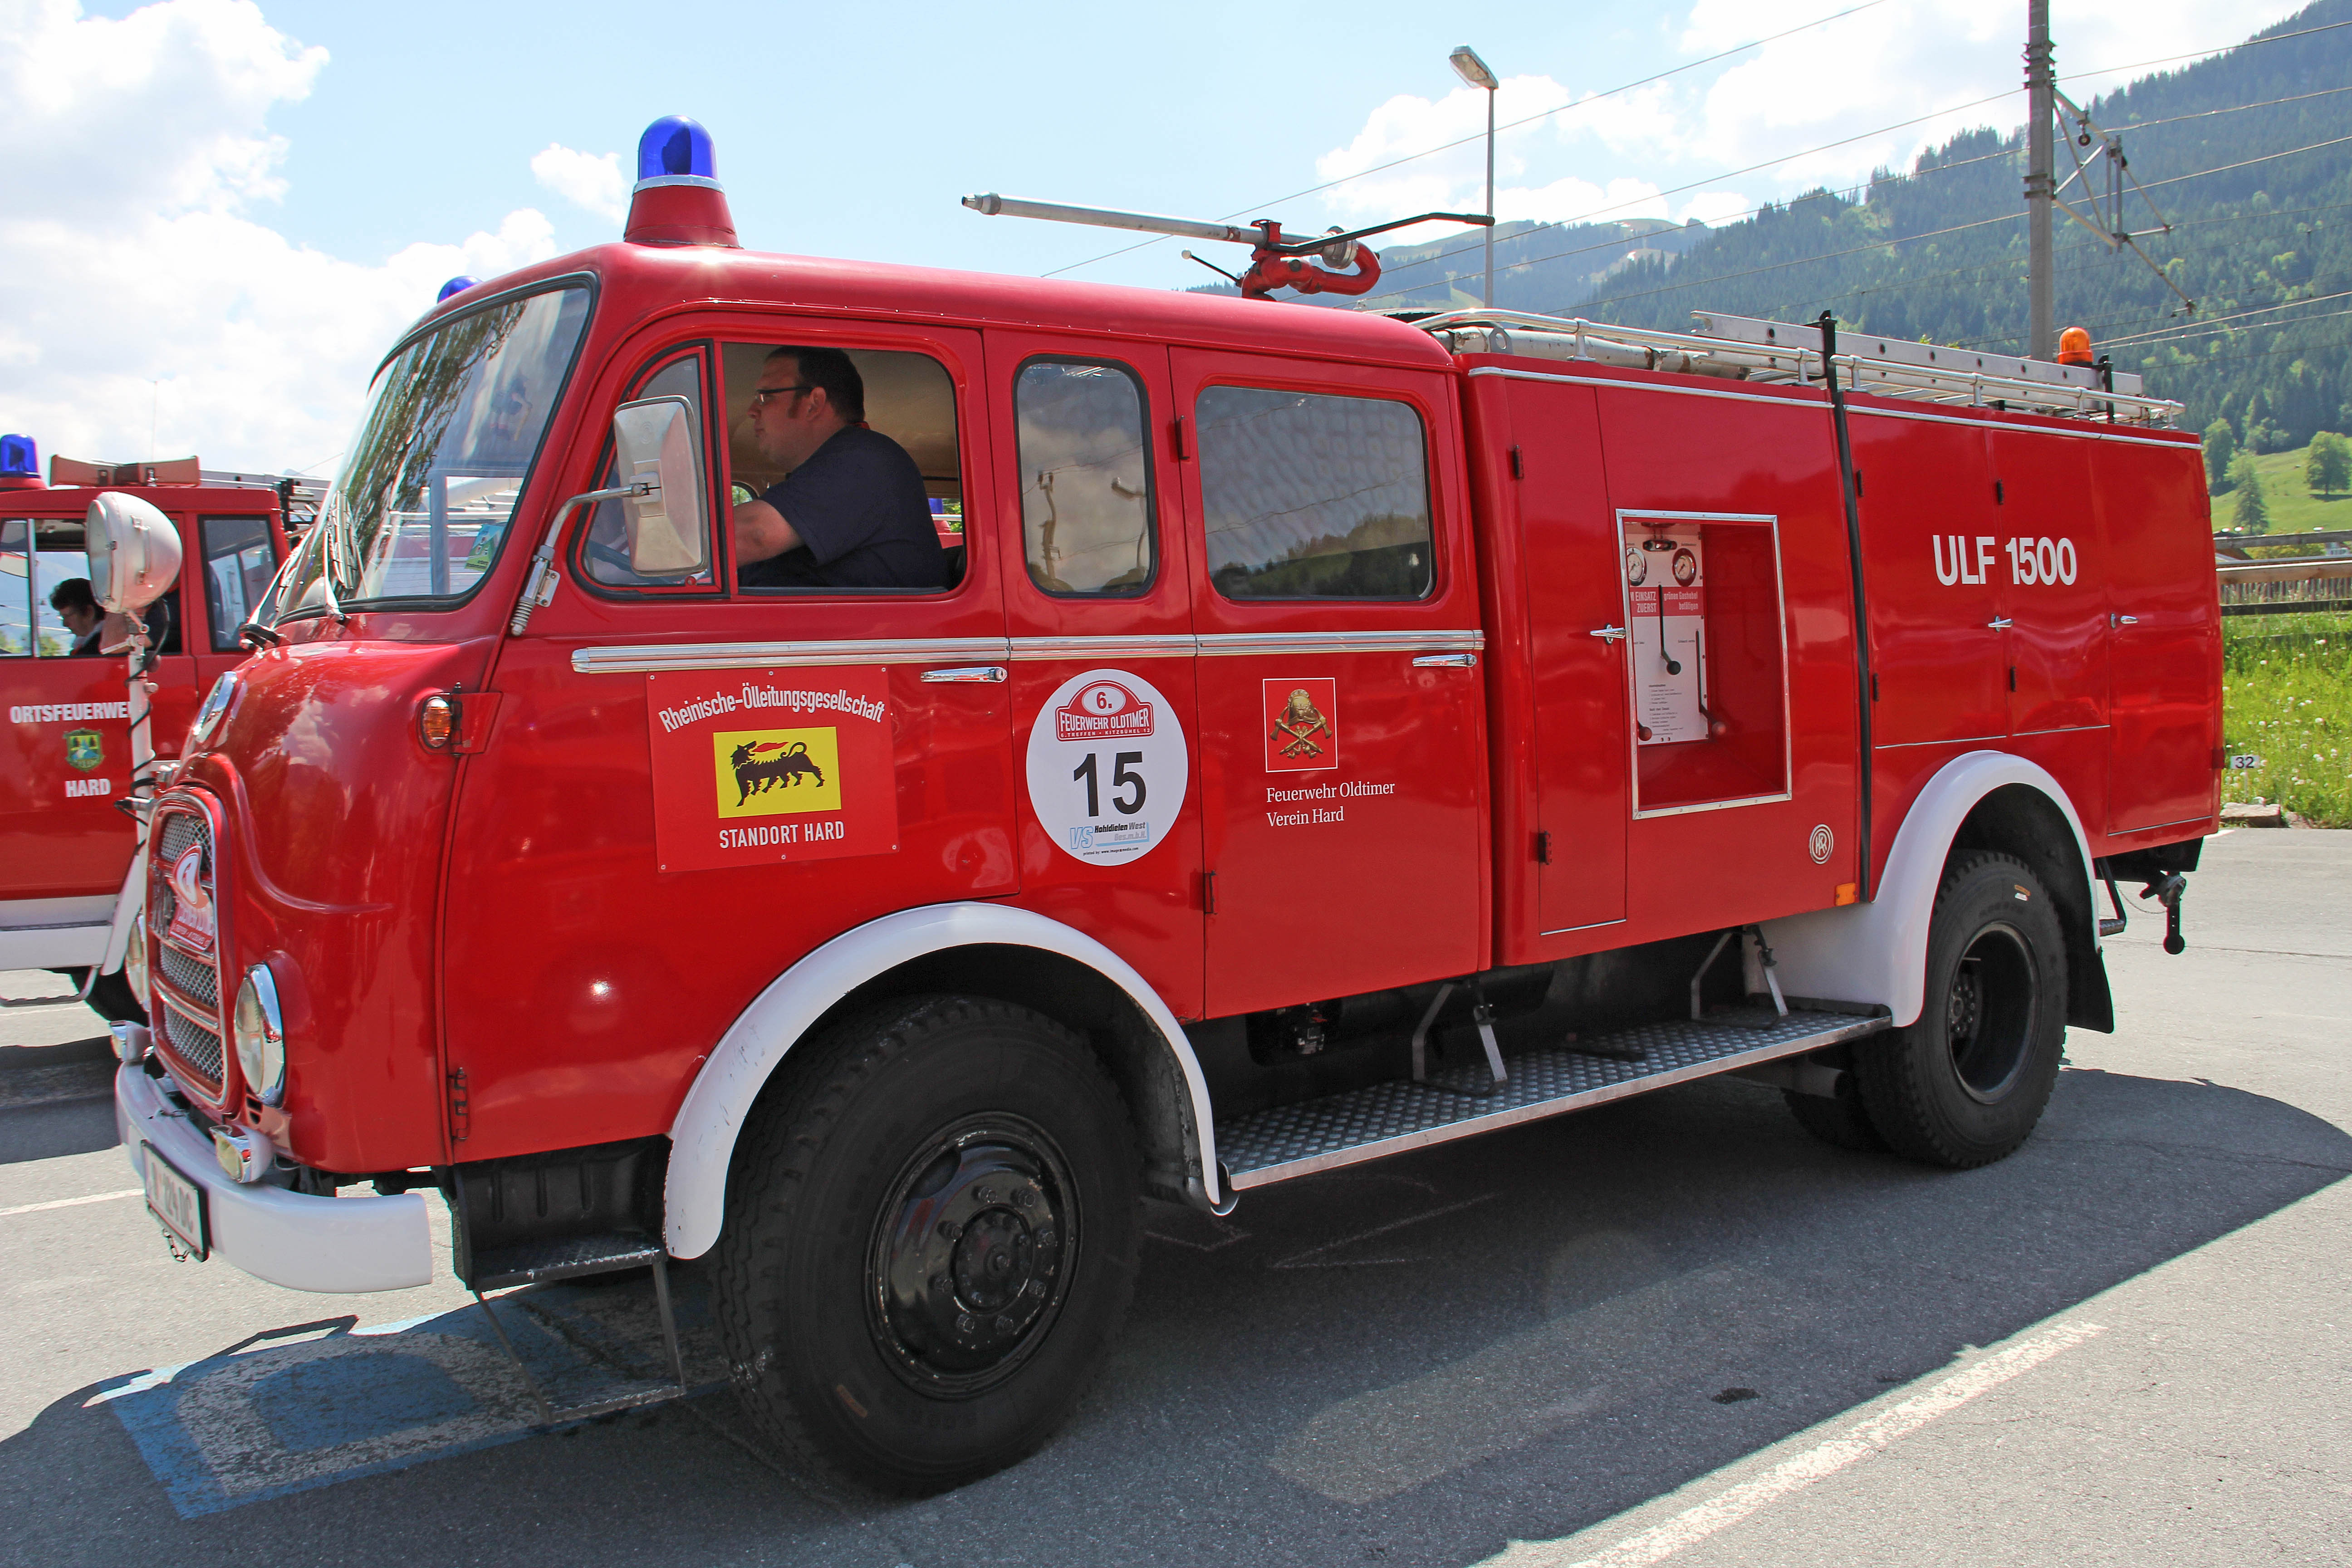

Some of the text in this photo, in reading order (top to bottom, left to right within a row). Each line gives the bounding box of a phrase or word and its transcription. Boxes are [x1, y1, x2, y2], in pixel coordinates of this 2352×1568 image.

[1932, 535, 2077, 586] ULF 1500
[1635, 591, 1656, 601] EINSATZ
[1637, 603, 1656, 612] ZUERST
[658, 682, 885, 733] Rheinische-Ölleitungsgesellschaft
[1096, 692, 1112, 709] 6.
[10, 701, 131, 724] ORTSFEUERWE
[1060, 707, 1150, 732] FEUERWEHR OLDTIMER
[2235, 756, 2254, 768] 32
[65, 778, 111, 797] HARD
[1073, 751, 1147, 817] 15
[1266, 781, 1395, 803] Feuerwehr Oldtimer
[1266, 806, 1344, 827] Verein Hard
[720, 821, 844, 849] STANDORT HARD
[1070, 826, 1094, 849] VS
[1129, 822, 1146, 830] West
